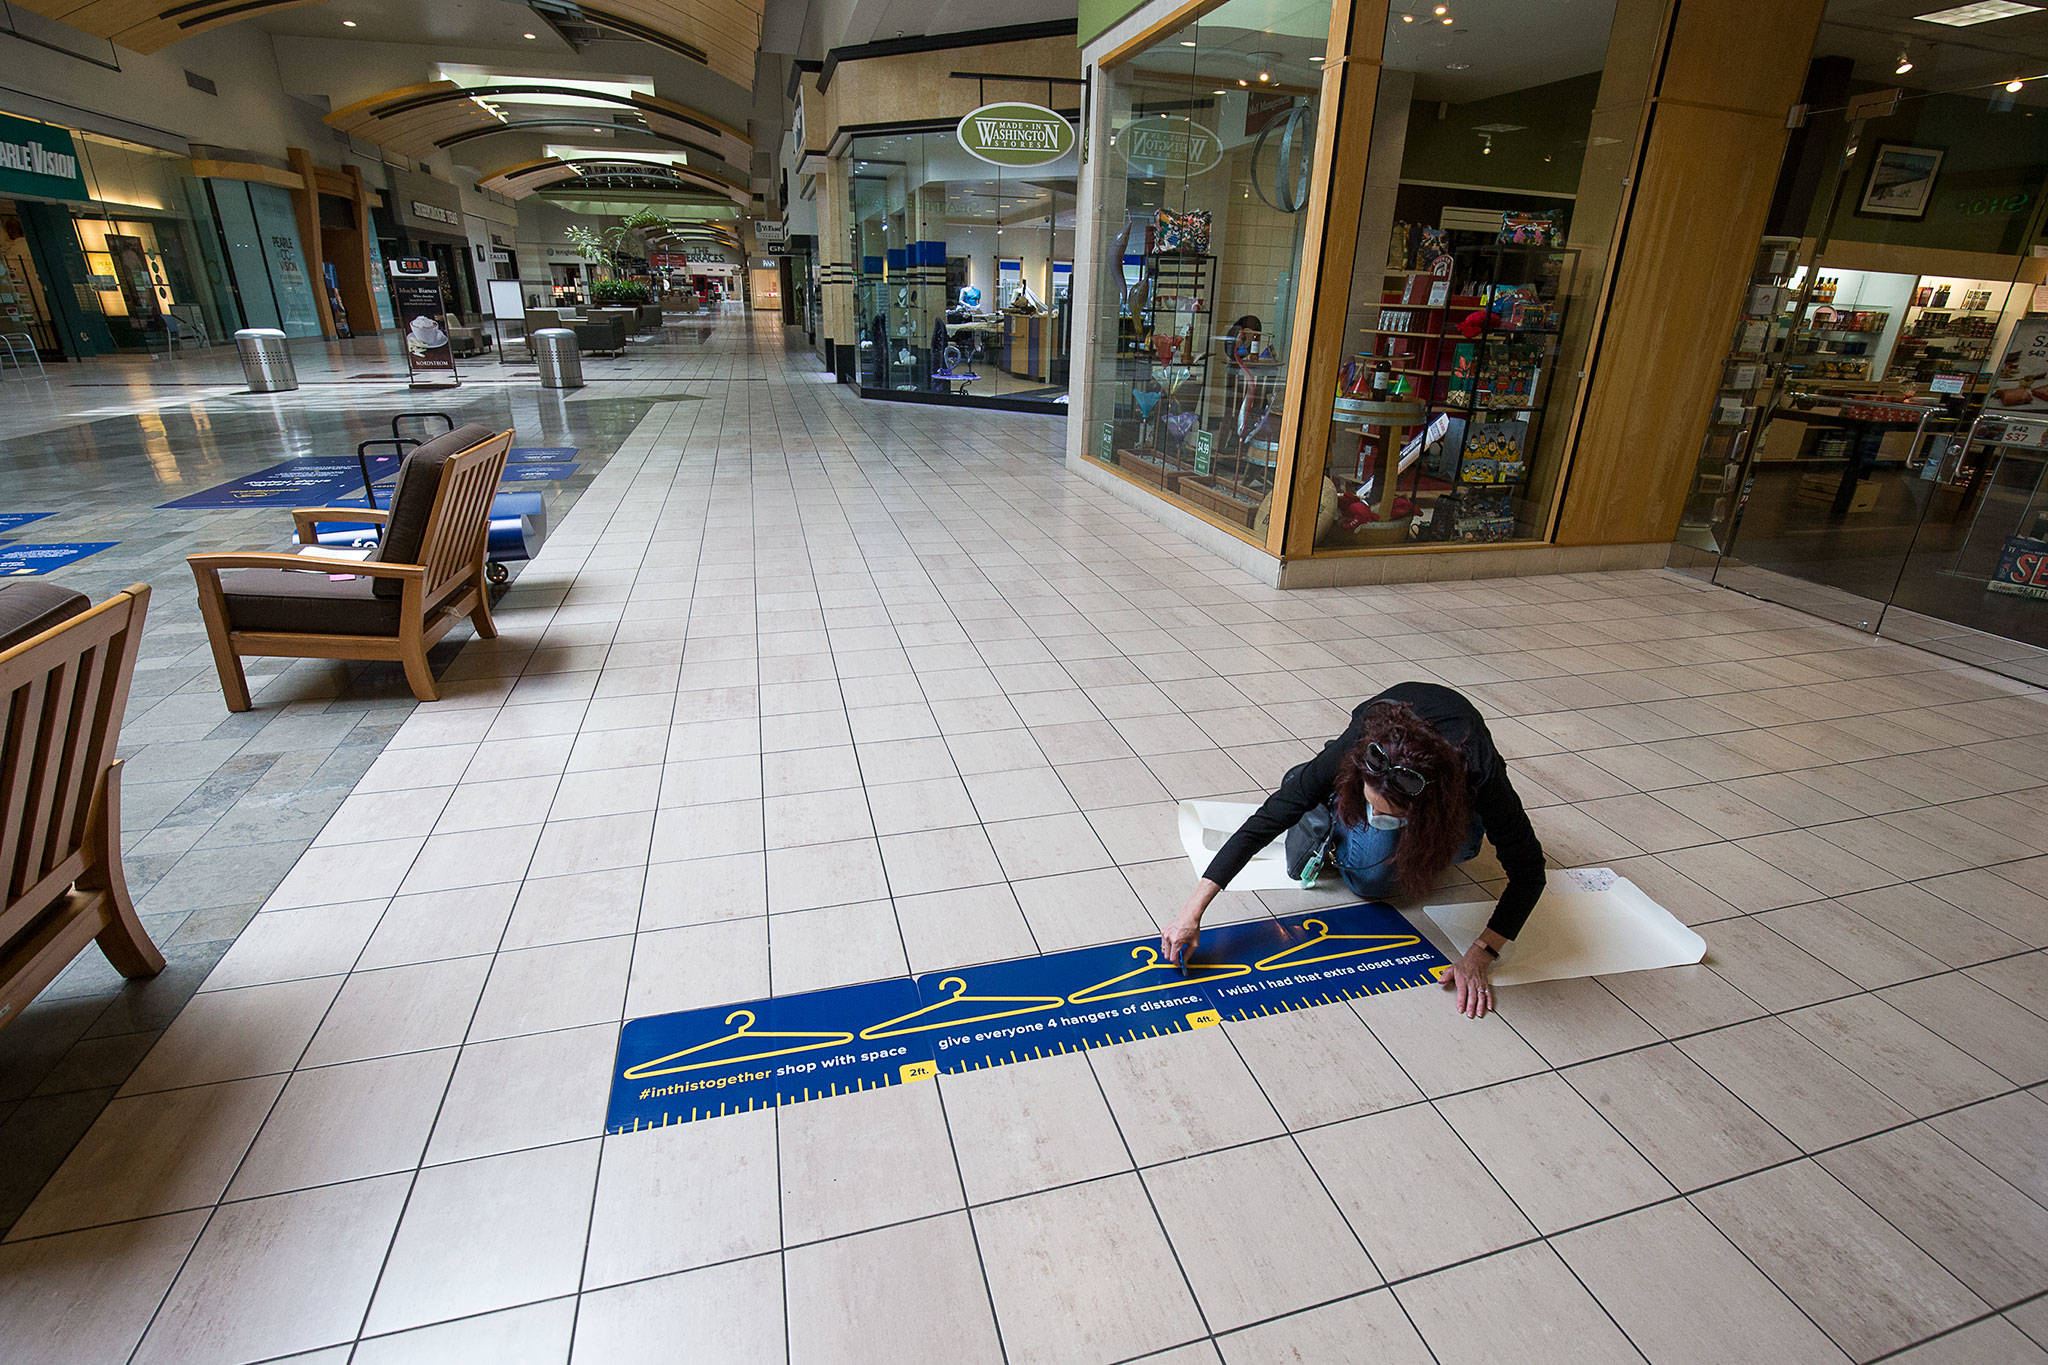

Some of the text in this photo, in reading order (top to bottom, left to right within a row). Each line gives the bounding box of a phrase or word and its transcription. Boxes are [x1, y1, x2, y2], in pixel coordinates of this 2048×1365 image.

[999, 121, 1023, 129] MADE
[975, 121, 1060, 149] WASHINGTON
[995, 140, 1041, 149] STORES
[693, 246, 710, 254] THE
[2005, 432, 2029, 441] $37
[1198, 441, 1209, 455] $4.99
[1217, 952, 1435, 998] I wish I had that extra closet space.
[938, 993, 1203, 1051] give everyone 4 hangers of distance.
[1196, 1014, 1215, 1026] 4ft.
[639, 1046, 907, 1101] #inthistogether shop with space
[909, 1067, 930, 1079] 2ft.
